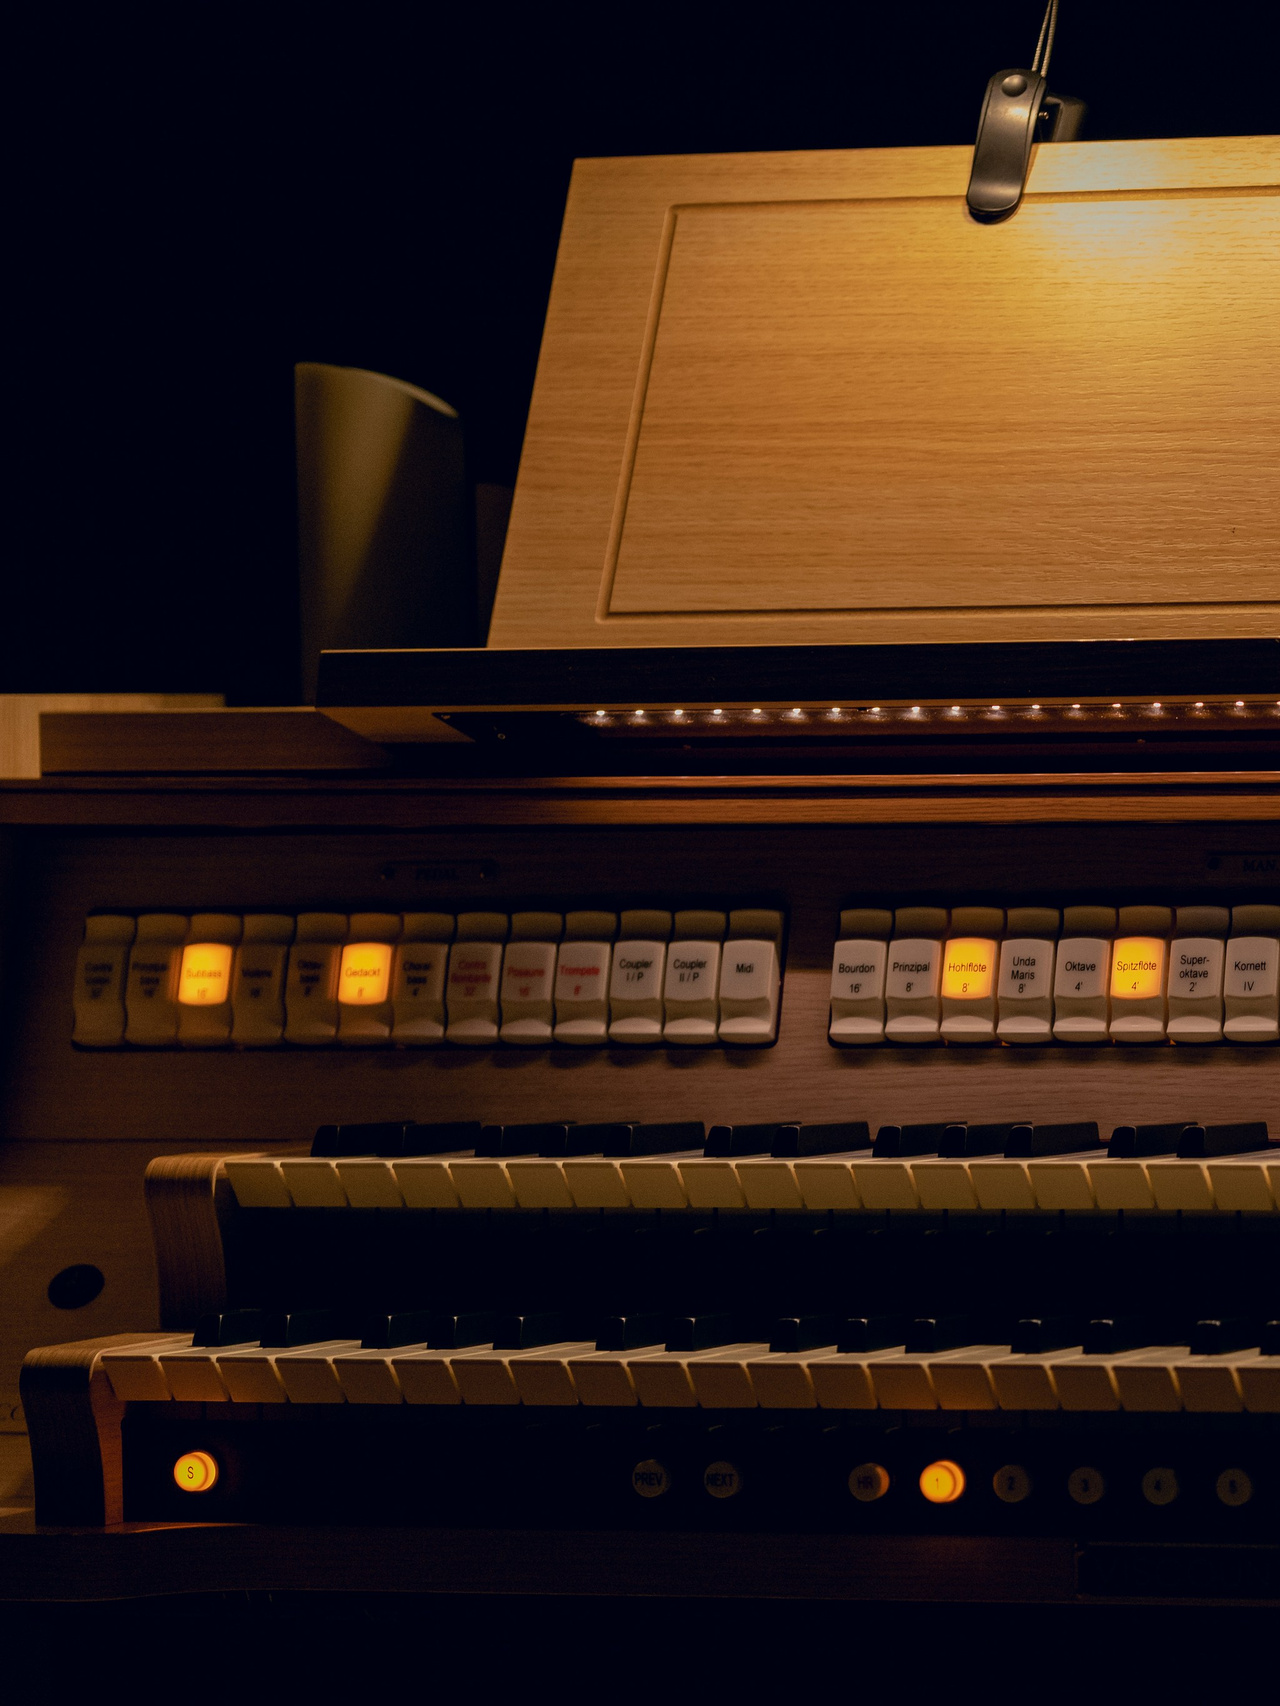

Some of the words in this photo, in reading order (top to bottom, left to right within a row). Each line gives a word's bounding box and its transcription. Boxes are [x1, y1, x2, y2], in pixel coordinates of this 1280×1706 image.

[619, 959, 653, 973] Coupler
[673, 959, 707, 972] Coupler
[1012, 956, 1036, 967] Unda
[1064, 960, 1097, 973] Oktave
[1179, 954, 1210, 967] Super-
[1233, 960, 1267, 972] Kornett
[345, 966, 381, 978] Gedackt
[560, 965, 600, 976] Trompete
[735, 963, 755, 974] Midi
[838, 963, 876, 974] Bourdon
[892, 961, 931, 974] Prinzipal
[1178, 967, 1209, 979] oktave
[1010, 969, 1036, 981] Maris
[849, 983, 863, 994] 16'
[905, 982, 914, 992] 8'
[961, 982, 970, 993] 8'
[1018, 983, 1027, 994] 8'
[1074, 981, 1083, 992] 4'
[1131, 981, 1140, 991] 4'
[1188, 982, 1197, 992] 2'
[1243, 981, 1254, 991] IV
[187, 1466, 194, 1480] S
[634, 1472, 663, 1487] PREV
[704, 1472, 734, 1487] NEXT
[858, 1475, 876, 1489] HR
